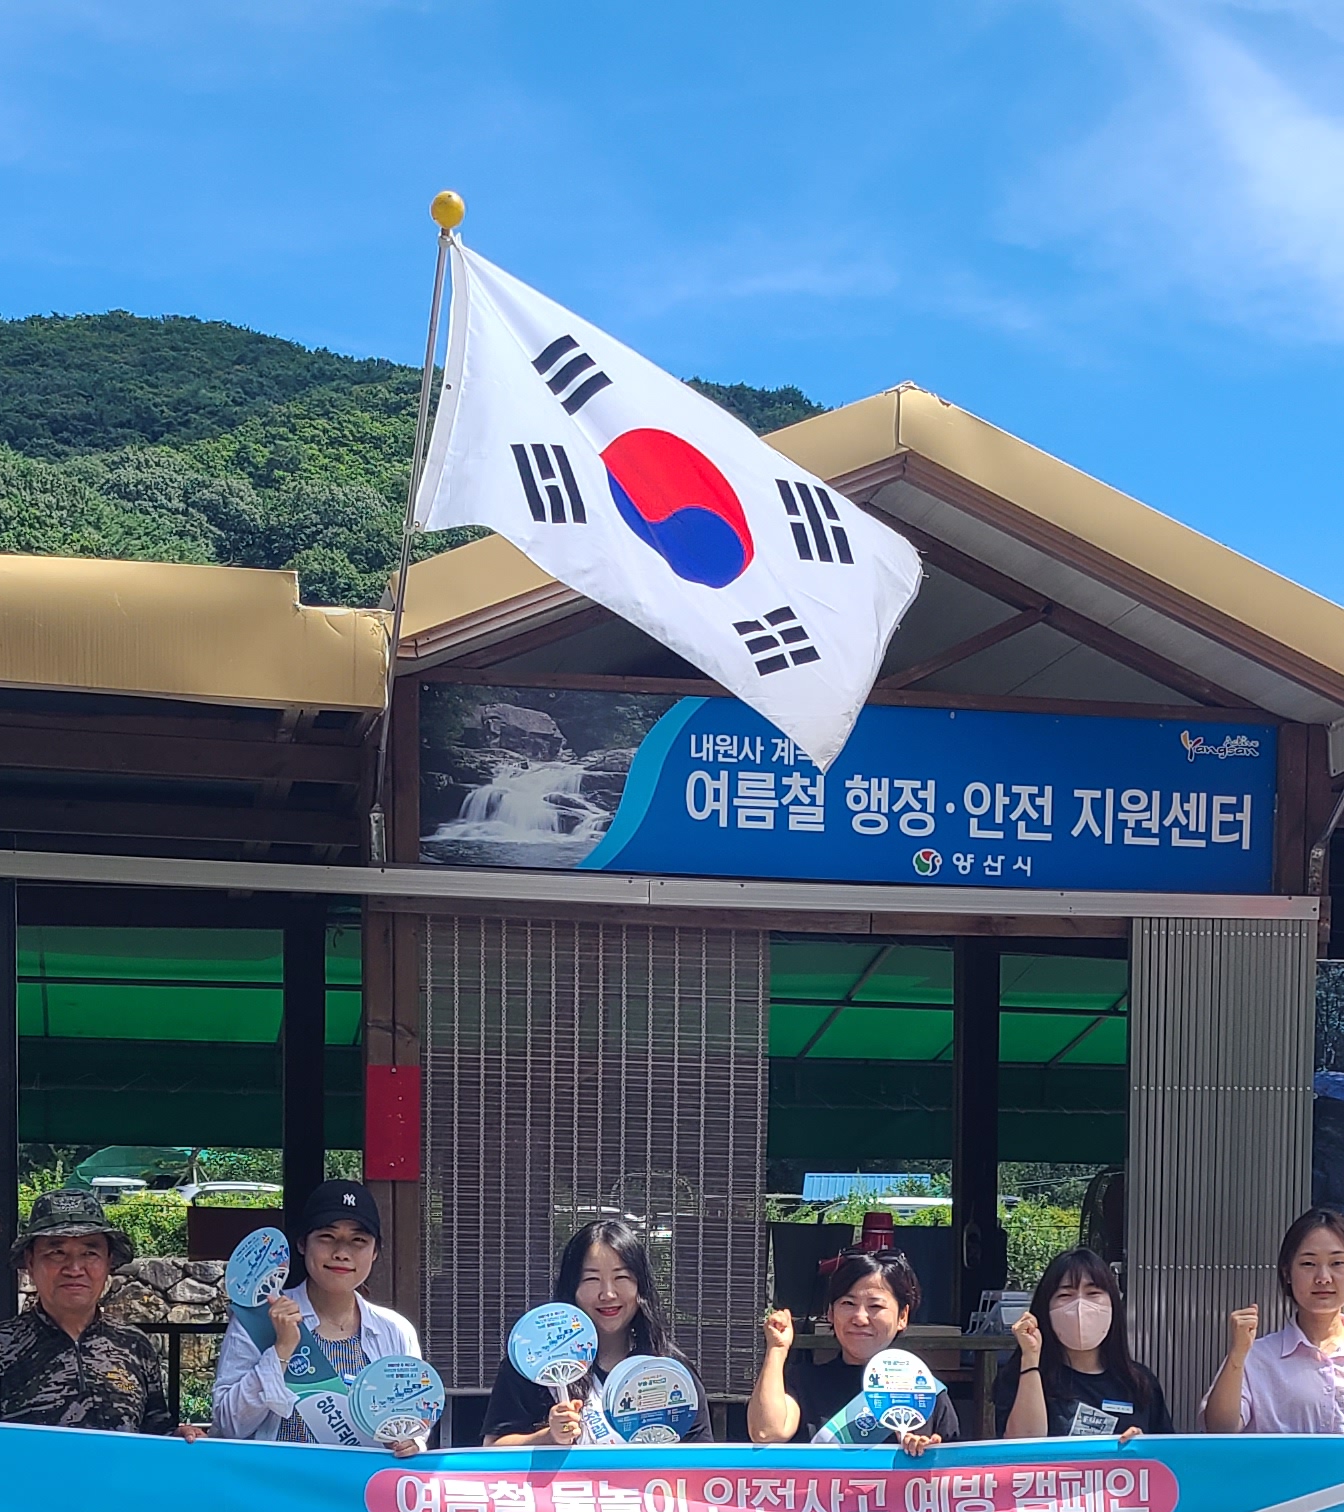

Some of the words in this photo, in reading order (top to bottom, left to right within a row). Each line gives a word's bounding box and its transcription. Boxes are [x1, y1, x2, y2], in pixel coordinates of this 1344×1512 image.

[690, 733, 764, 764] 내원사
[1180, 730, 1260, 762] Yangsan
[685, 770, 826, 833] 여름철
[1071, 787, 1253, 851] 지원센터
[952, 852, 1032, 877] 양산시
